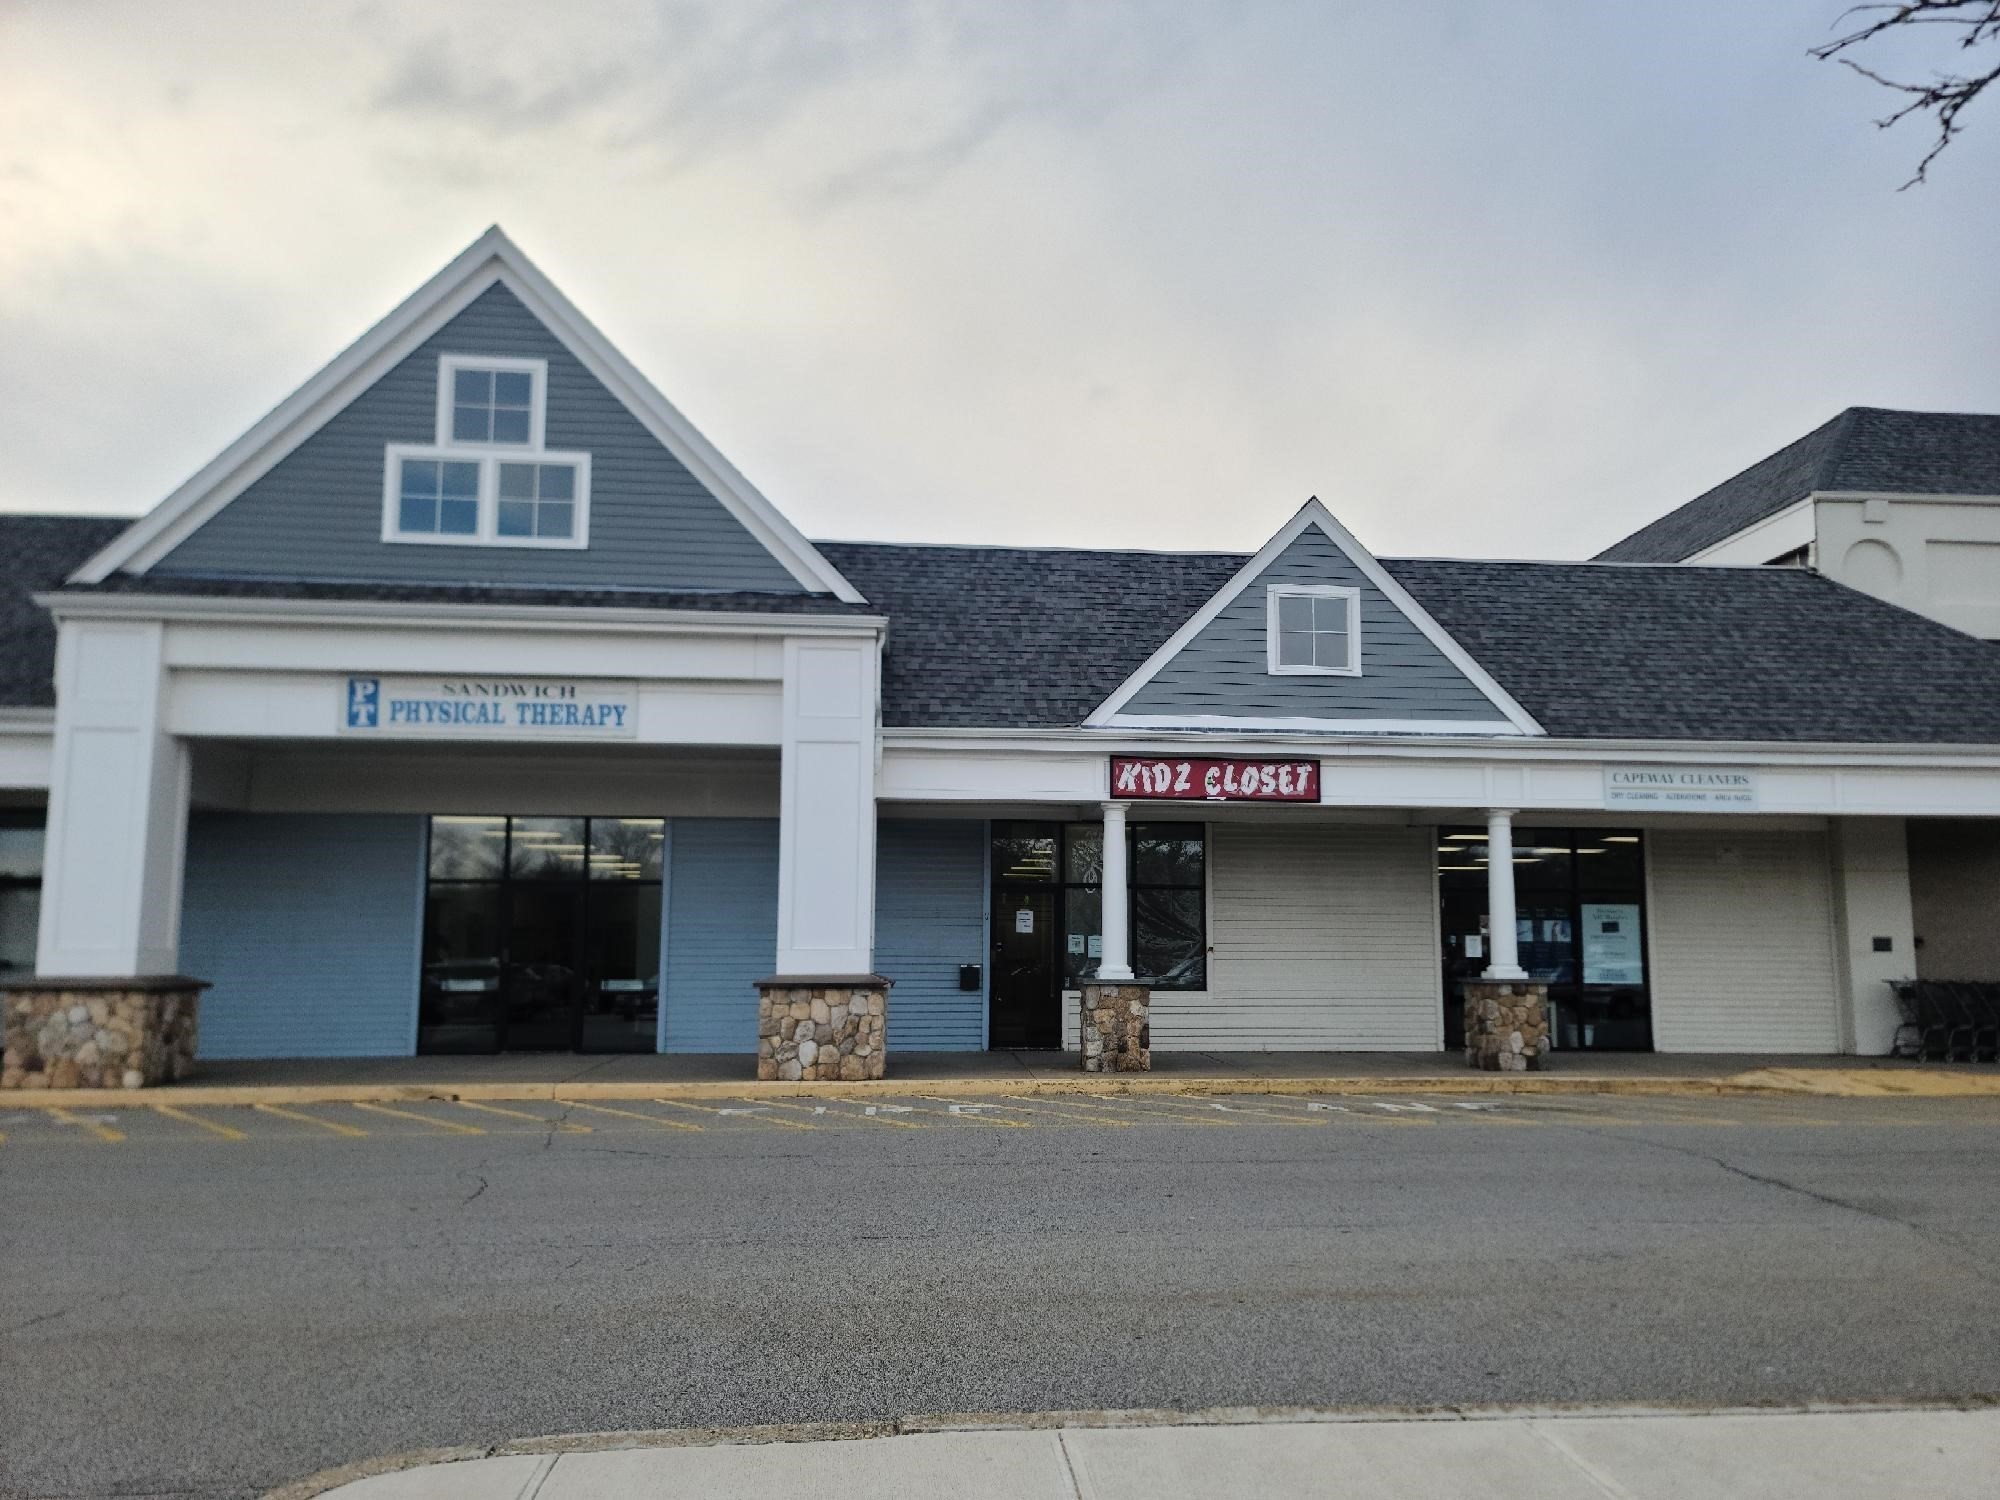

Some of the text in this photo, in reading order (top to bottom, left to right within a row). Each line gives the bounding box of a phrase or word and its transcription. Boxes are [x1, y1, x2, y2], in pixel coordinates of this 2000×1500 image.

[443, 683, 577, 699] SANDWICH
[389, 699, 628, 727] PHYSICAL THERAPY
[1117, 762, 1313, 796] KIDZ CLOSET
[1612, 772, 1750, 786] CAPEWAY CLEANERS
